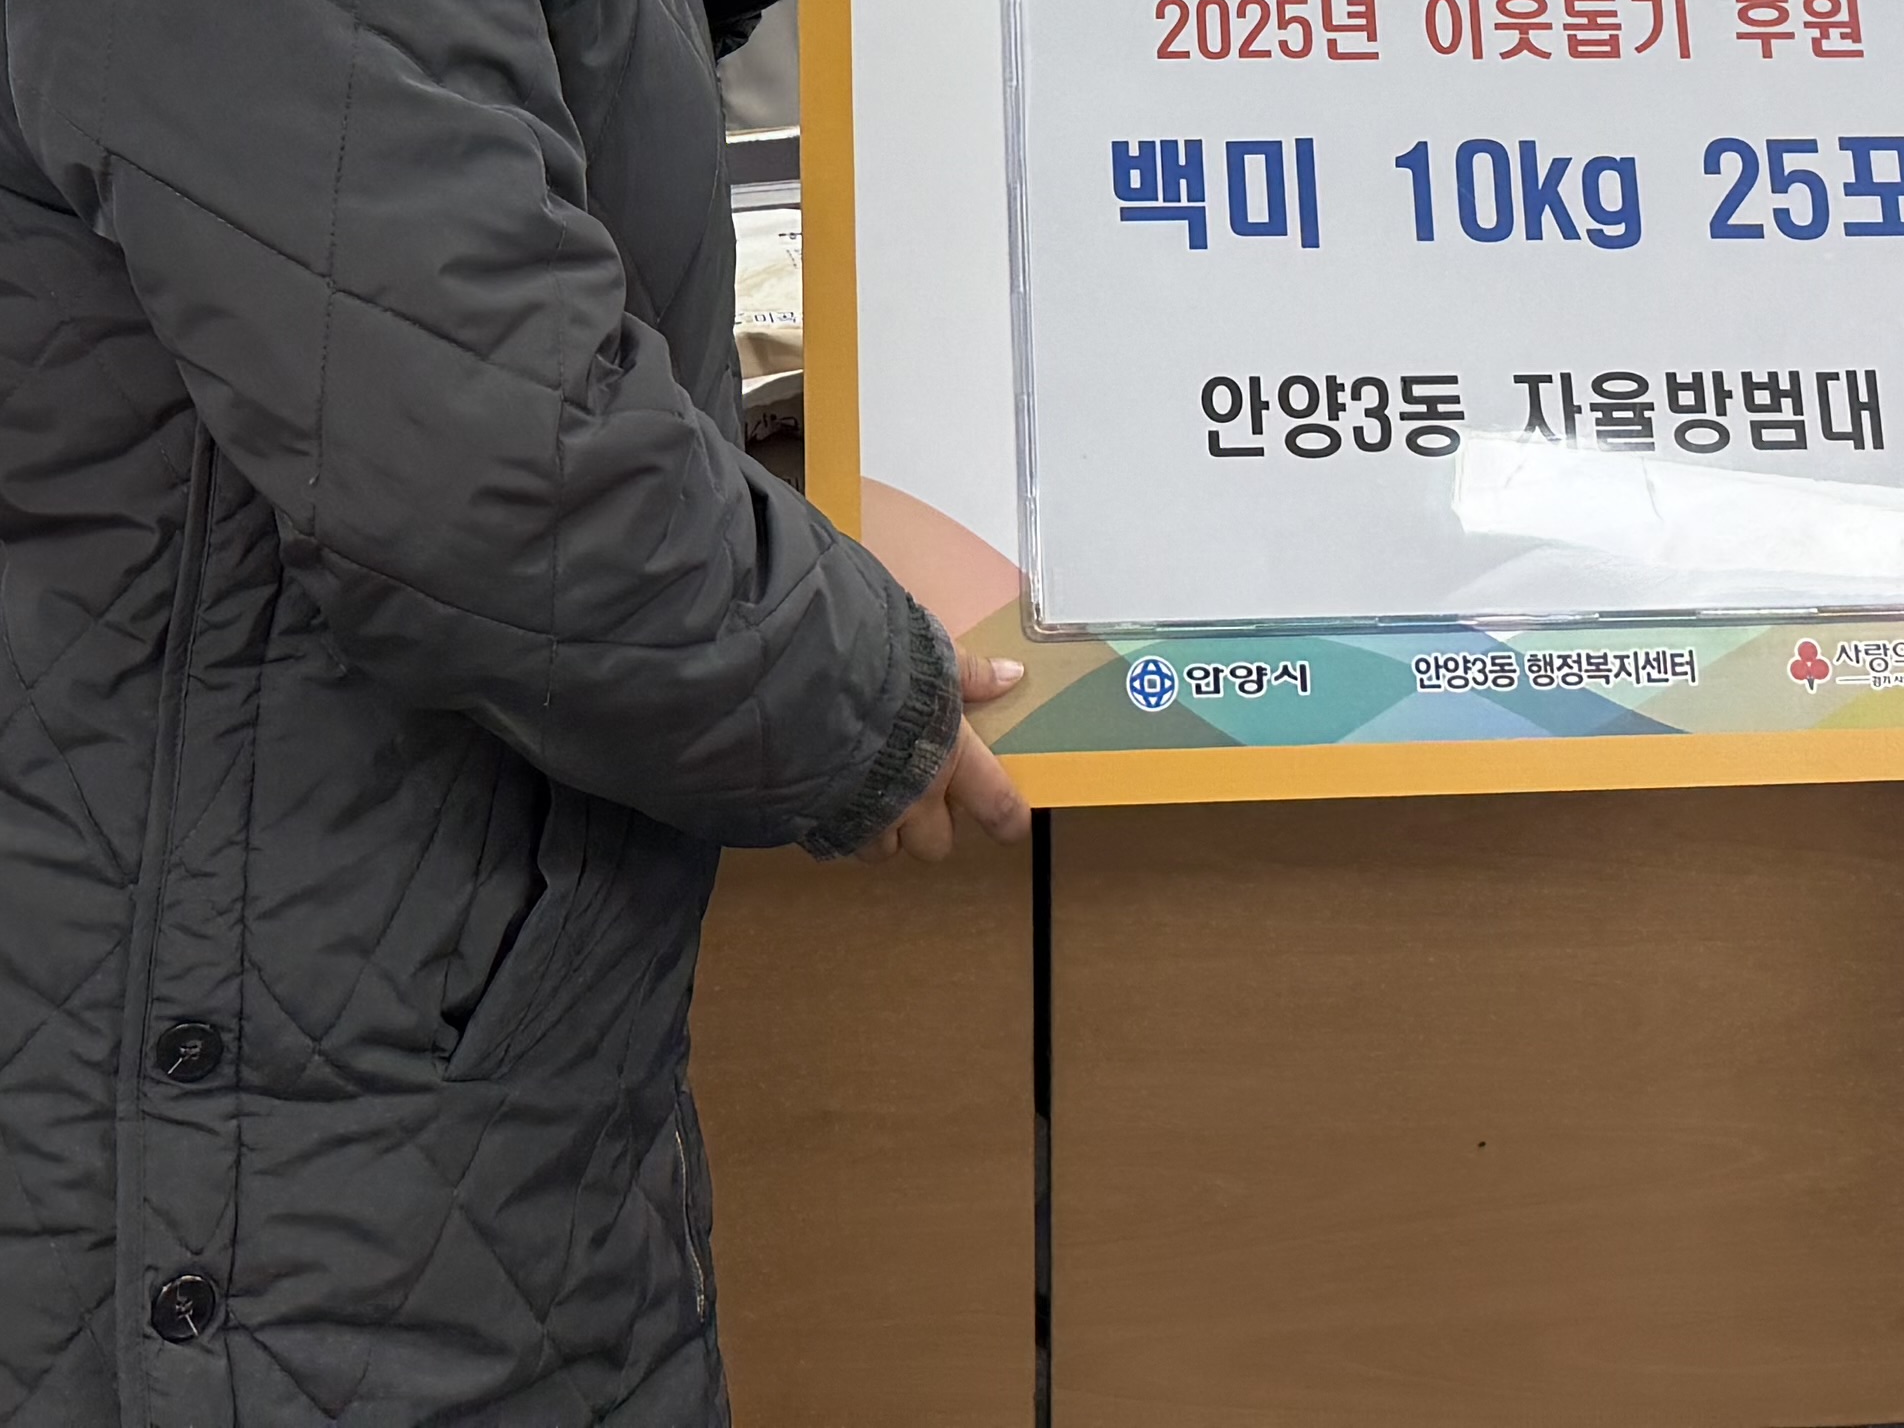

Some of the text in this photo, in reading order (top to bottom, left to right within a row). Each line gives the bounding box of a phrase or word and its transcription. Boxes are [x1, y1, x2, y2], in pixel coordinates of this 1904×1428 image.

[1110, 135, 1322, 251] 백미
[1394, 138, 1643, 252] 10kg
[1198, 370, 1886, 459] 안양3동 자율방범대
[1187, 664, 1309, 695] 안양시
[1414, 649, 1697, 689] 안양3동 행정복지센터
